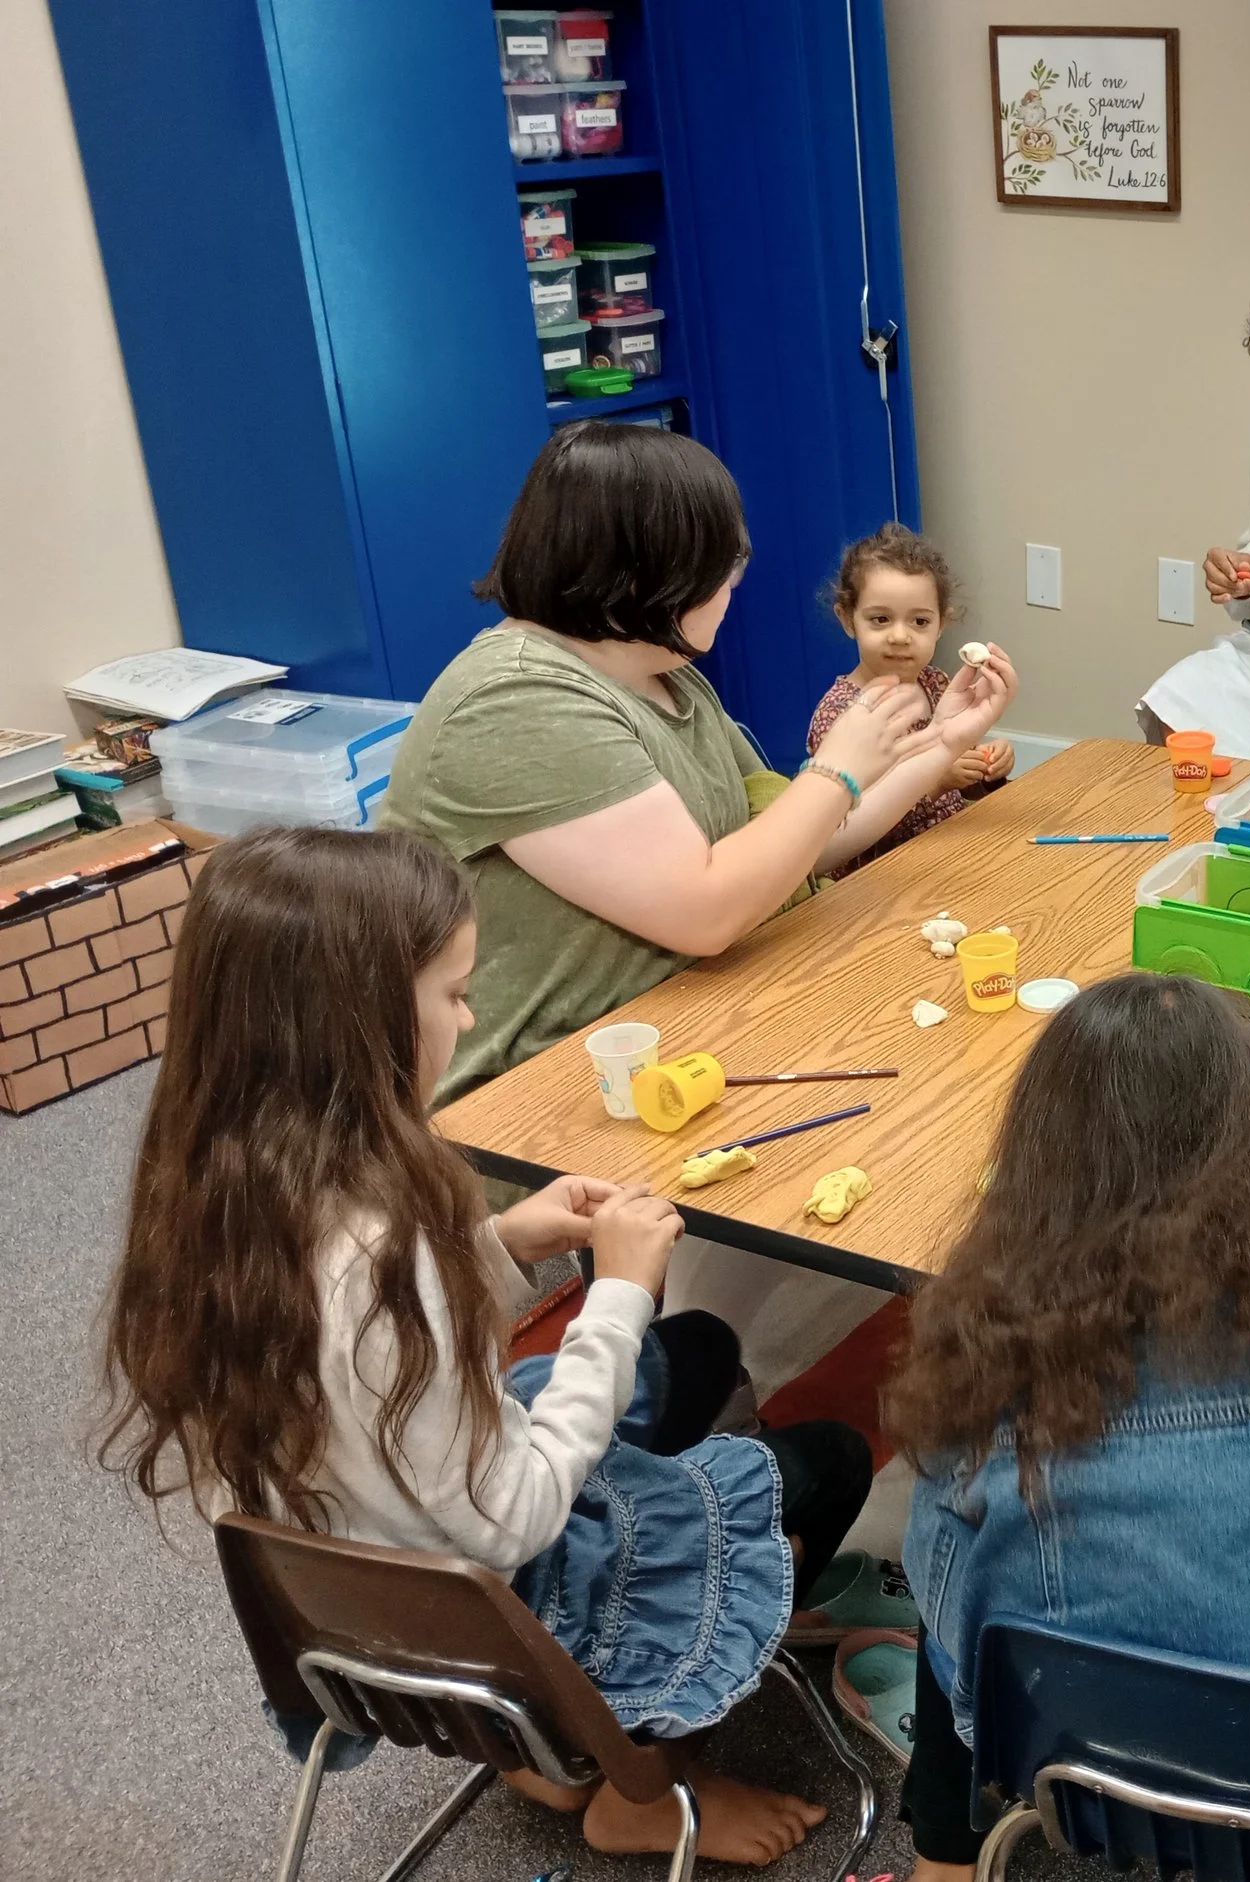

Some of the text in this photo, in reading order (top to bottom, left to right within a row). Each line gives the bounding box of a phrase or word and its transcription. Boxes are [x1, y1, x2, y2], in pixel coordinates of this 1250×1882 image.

[1067, 60, 1128, 89] Not one
[1088, 92, 1145, 117] sparrow
[581, 113, 612, 124] feathers
[1078, 114, 1160, 142] is forgotten
[1084, 139, 1157, 167] before God
[1107, 165, 1141, 189] Luke
